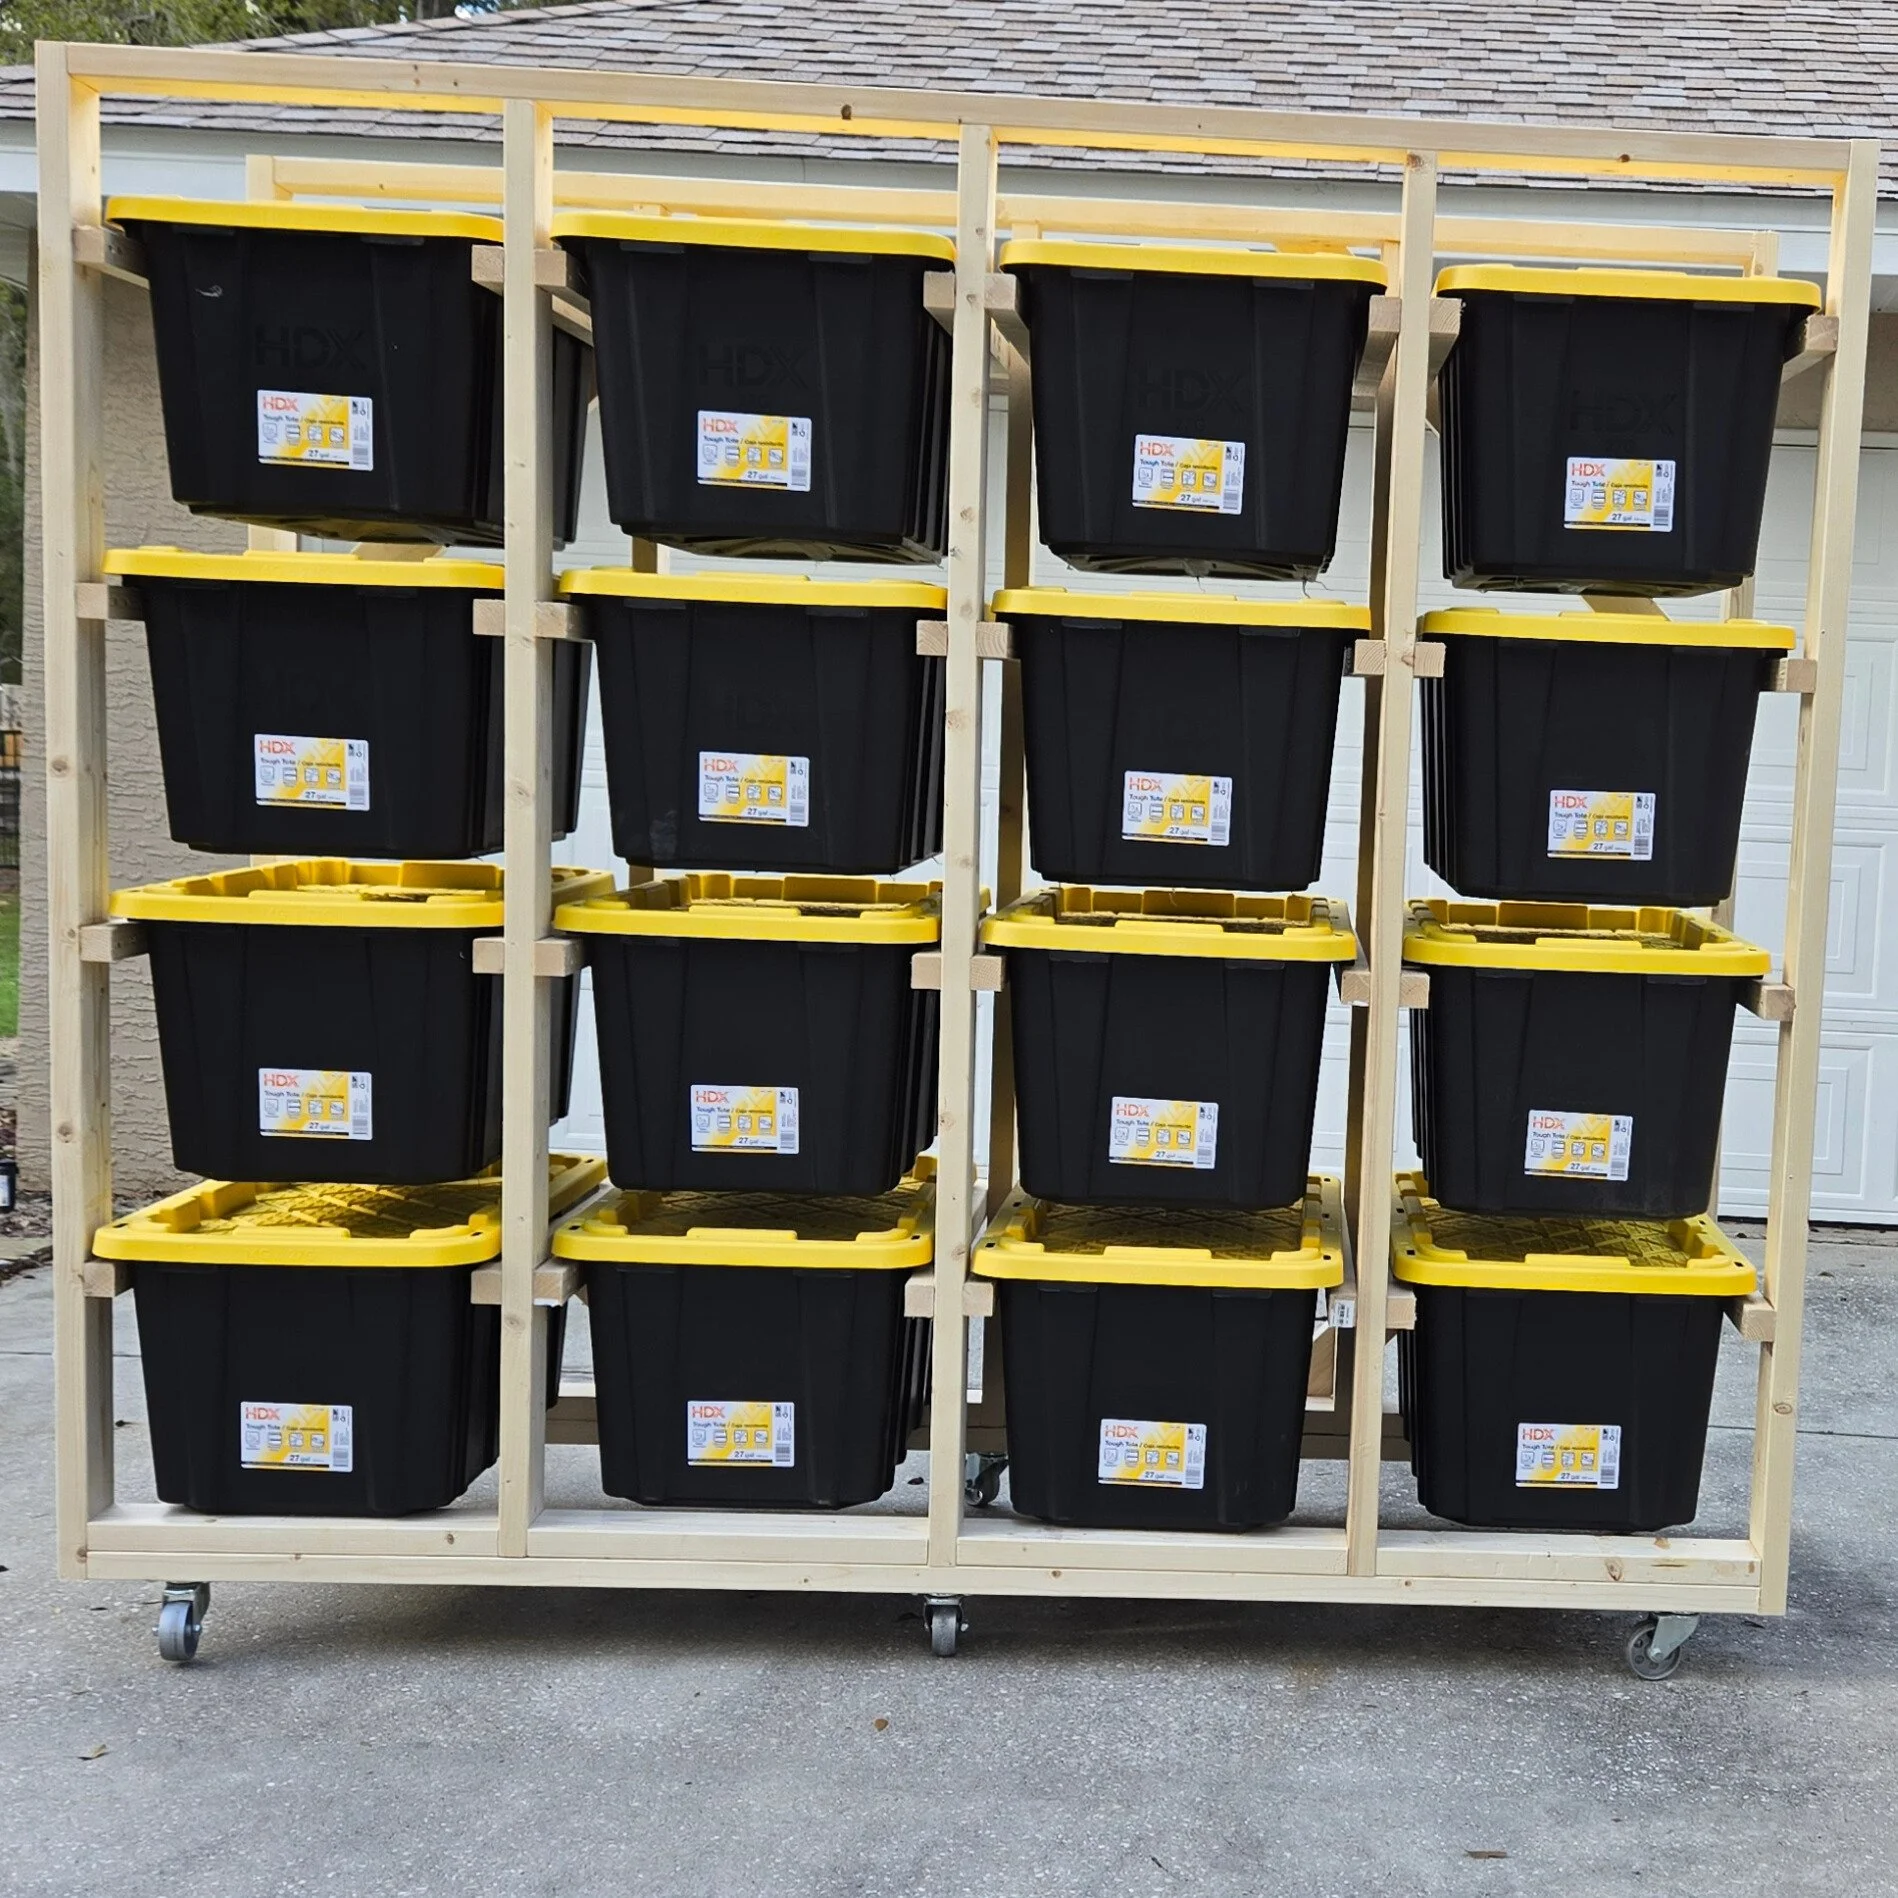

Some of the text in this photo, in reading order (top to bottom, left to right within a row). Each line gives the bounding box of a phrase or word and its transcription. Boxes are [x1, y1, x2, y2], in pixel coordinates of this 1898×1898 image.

[256, 323, 368, 371] HDX
[700, 343, 809, 390] HDX
[1134, 369, 1244, 413] HDX
[263, 396, 299, 413] HDX
[703, 417, 739, 434] HDX
[704, 435, 724, 443] Tough
[308, 450, 319, 458] 27
[1140, 440, 1175, 457] HDX
[1140, 459, 1160, 467] Tough
[747, 471, 758, 479] 27
[1572, 463, 1606, 478] HDX
[1571, 480, 1591, 488] Tough
[1180, 494, 1191, 502] 27
[1612, 513, 1622, 521] 27
[260, 740, 295, 756] HDX
[704, 757, 739, 773] HDX
[1129, 777, 1163, 792] HDX
[305, 791, 316, 799] 27
[1554, 795, 1588, 809] HDX
[1169, 827, 1180, 835] 27
[264, 1074, 299, 1088] HDX
[696, 1090, 729, 1104] HDX
[1116, 1102, 1150, 1117] HDX
[309, 1122, 320, 1130] 27
[1533, 1115, 1566, 1130] HDX
[1532, 1131, 1551, 1139] Tough
[246, 1407, 281, 1421] HDX
[693, 1406, 726, 1419] HDX
[1105, 1424, 1139, 1439] HDX
[1522, 1428, 1555, 1441] HDX
[1144, 1471, 1155, 1479] 27
